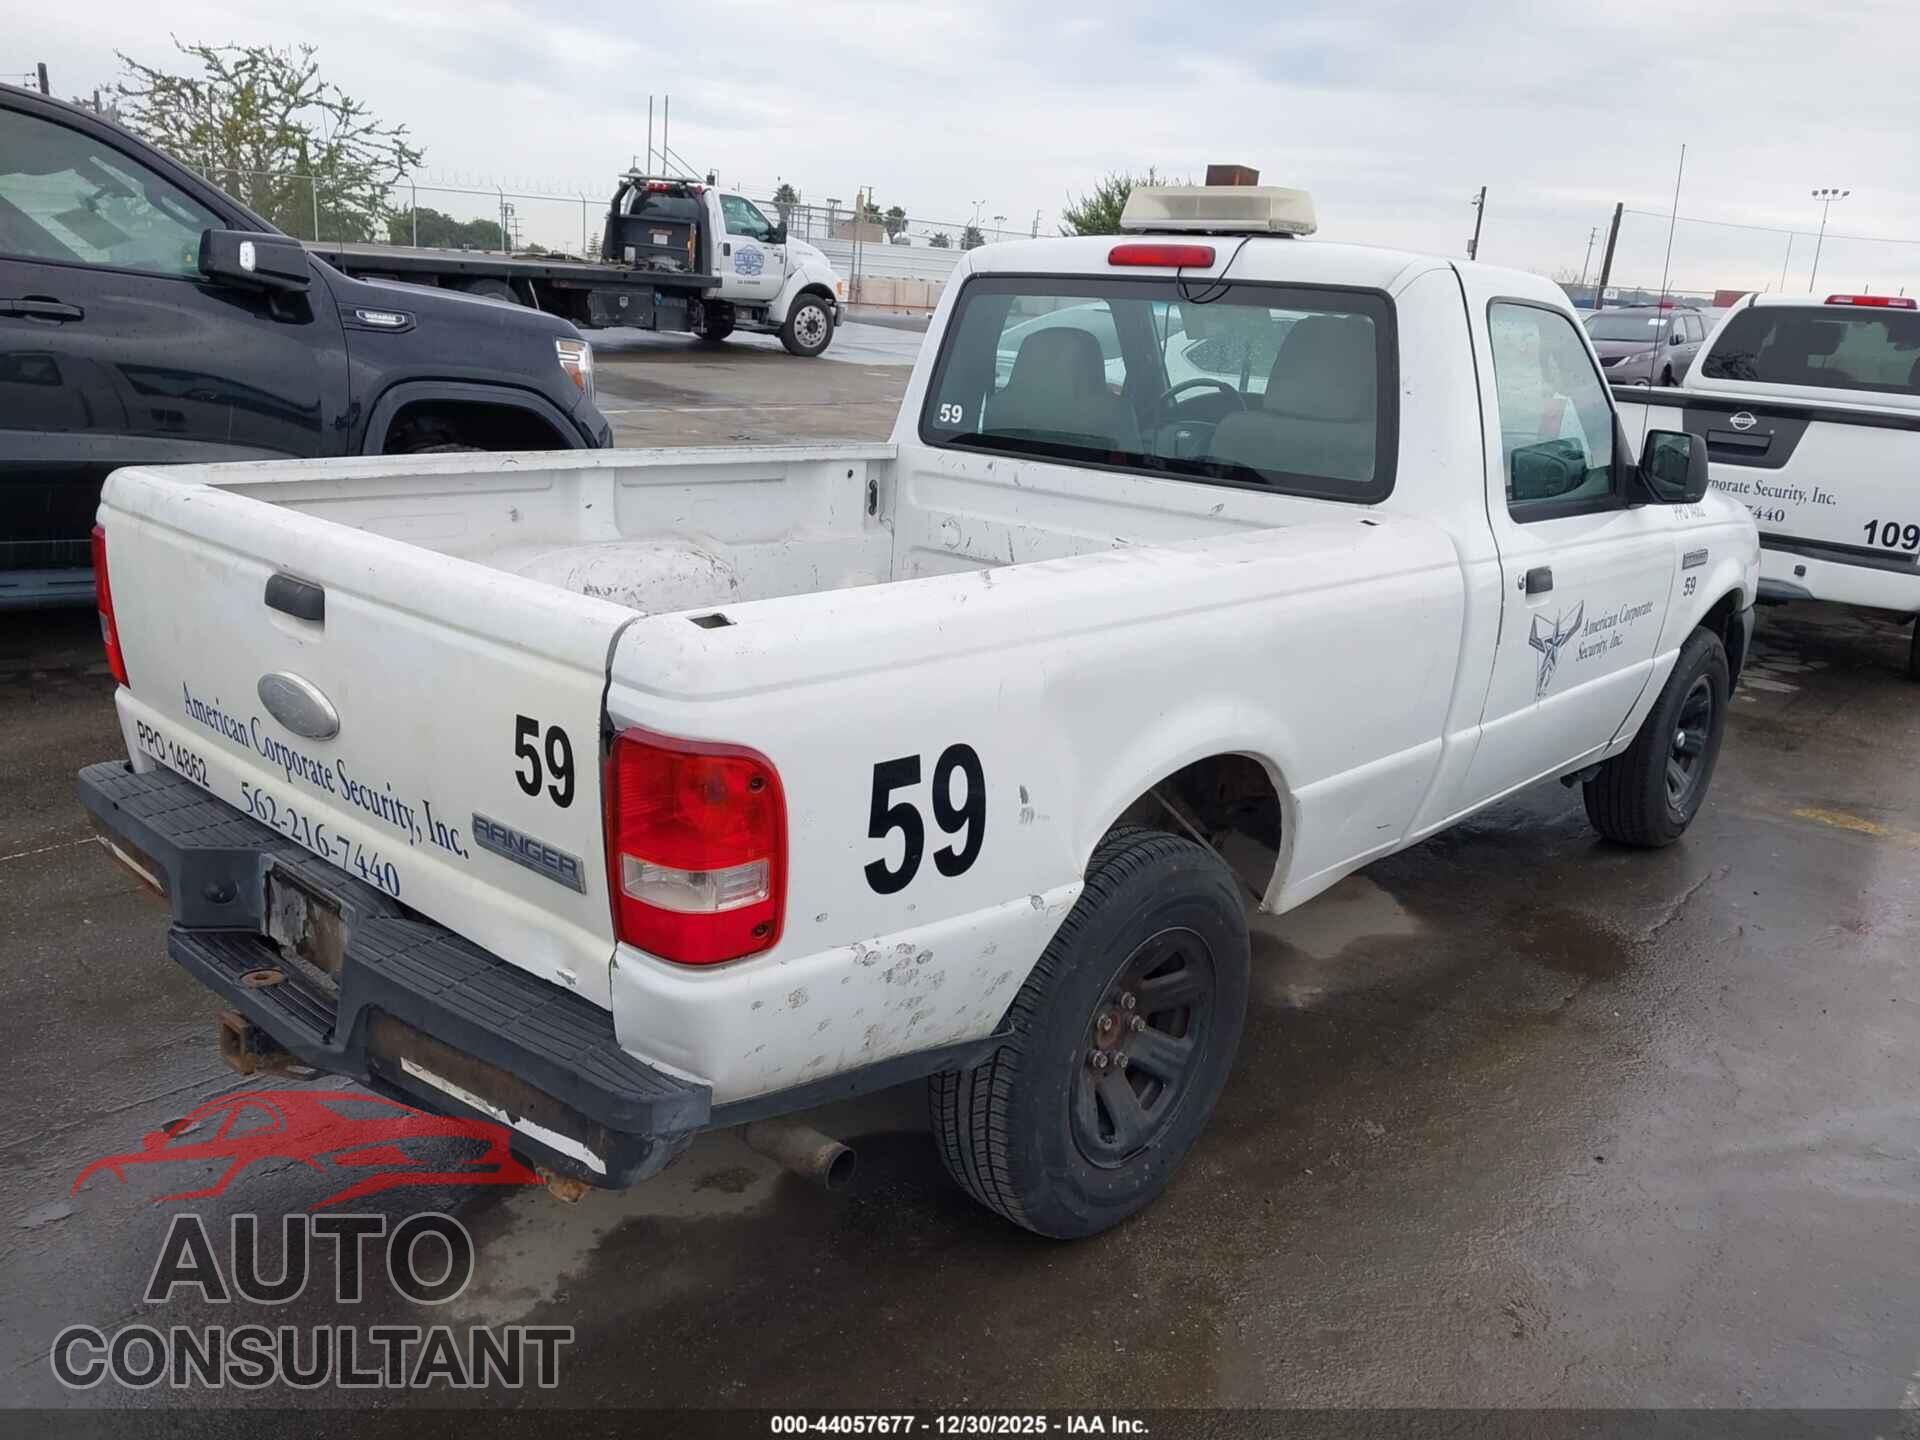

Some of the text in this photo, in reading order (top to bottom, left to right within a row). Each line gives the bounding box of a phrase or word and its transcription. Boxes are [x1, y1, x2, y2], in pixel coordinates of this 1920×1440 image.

[940, 403, 963, 423] 59
[1754, 480, 1807, 506] Security,
[1813, 486, 1837, 505] Inc.
[1864, 519, 1920, 550] 109
[1683, 576, 1697, 597] 59
[1581, 601, 1653, 637] American Corporate
[137, 719, 211, 788] PPO 14862
[183, 680, 470, 860] American Corporate Security, Inc.
[515, 714, 575, 808] 59
[241, 781, 401, 897] 562-216-7440
[473, 815, 577, 876] RANGER
[864, 743, 986, 895] 59
